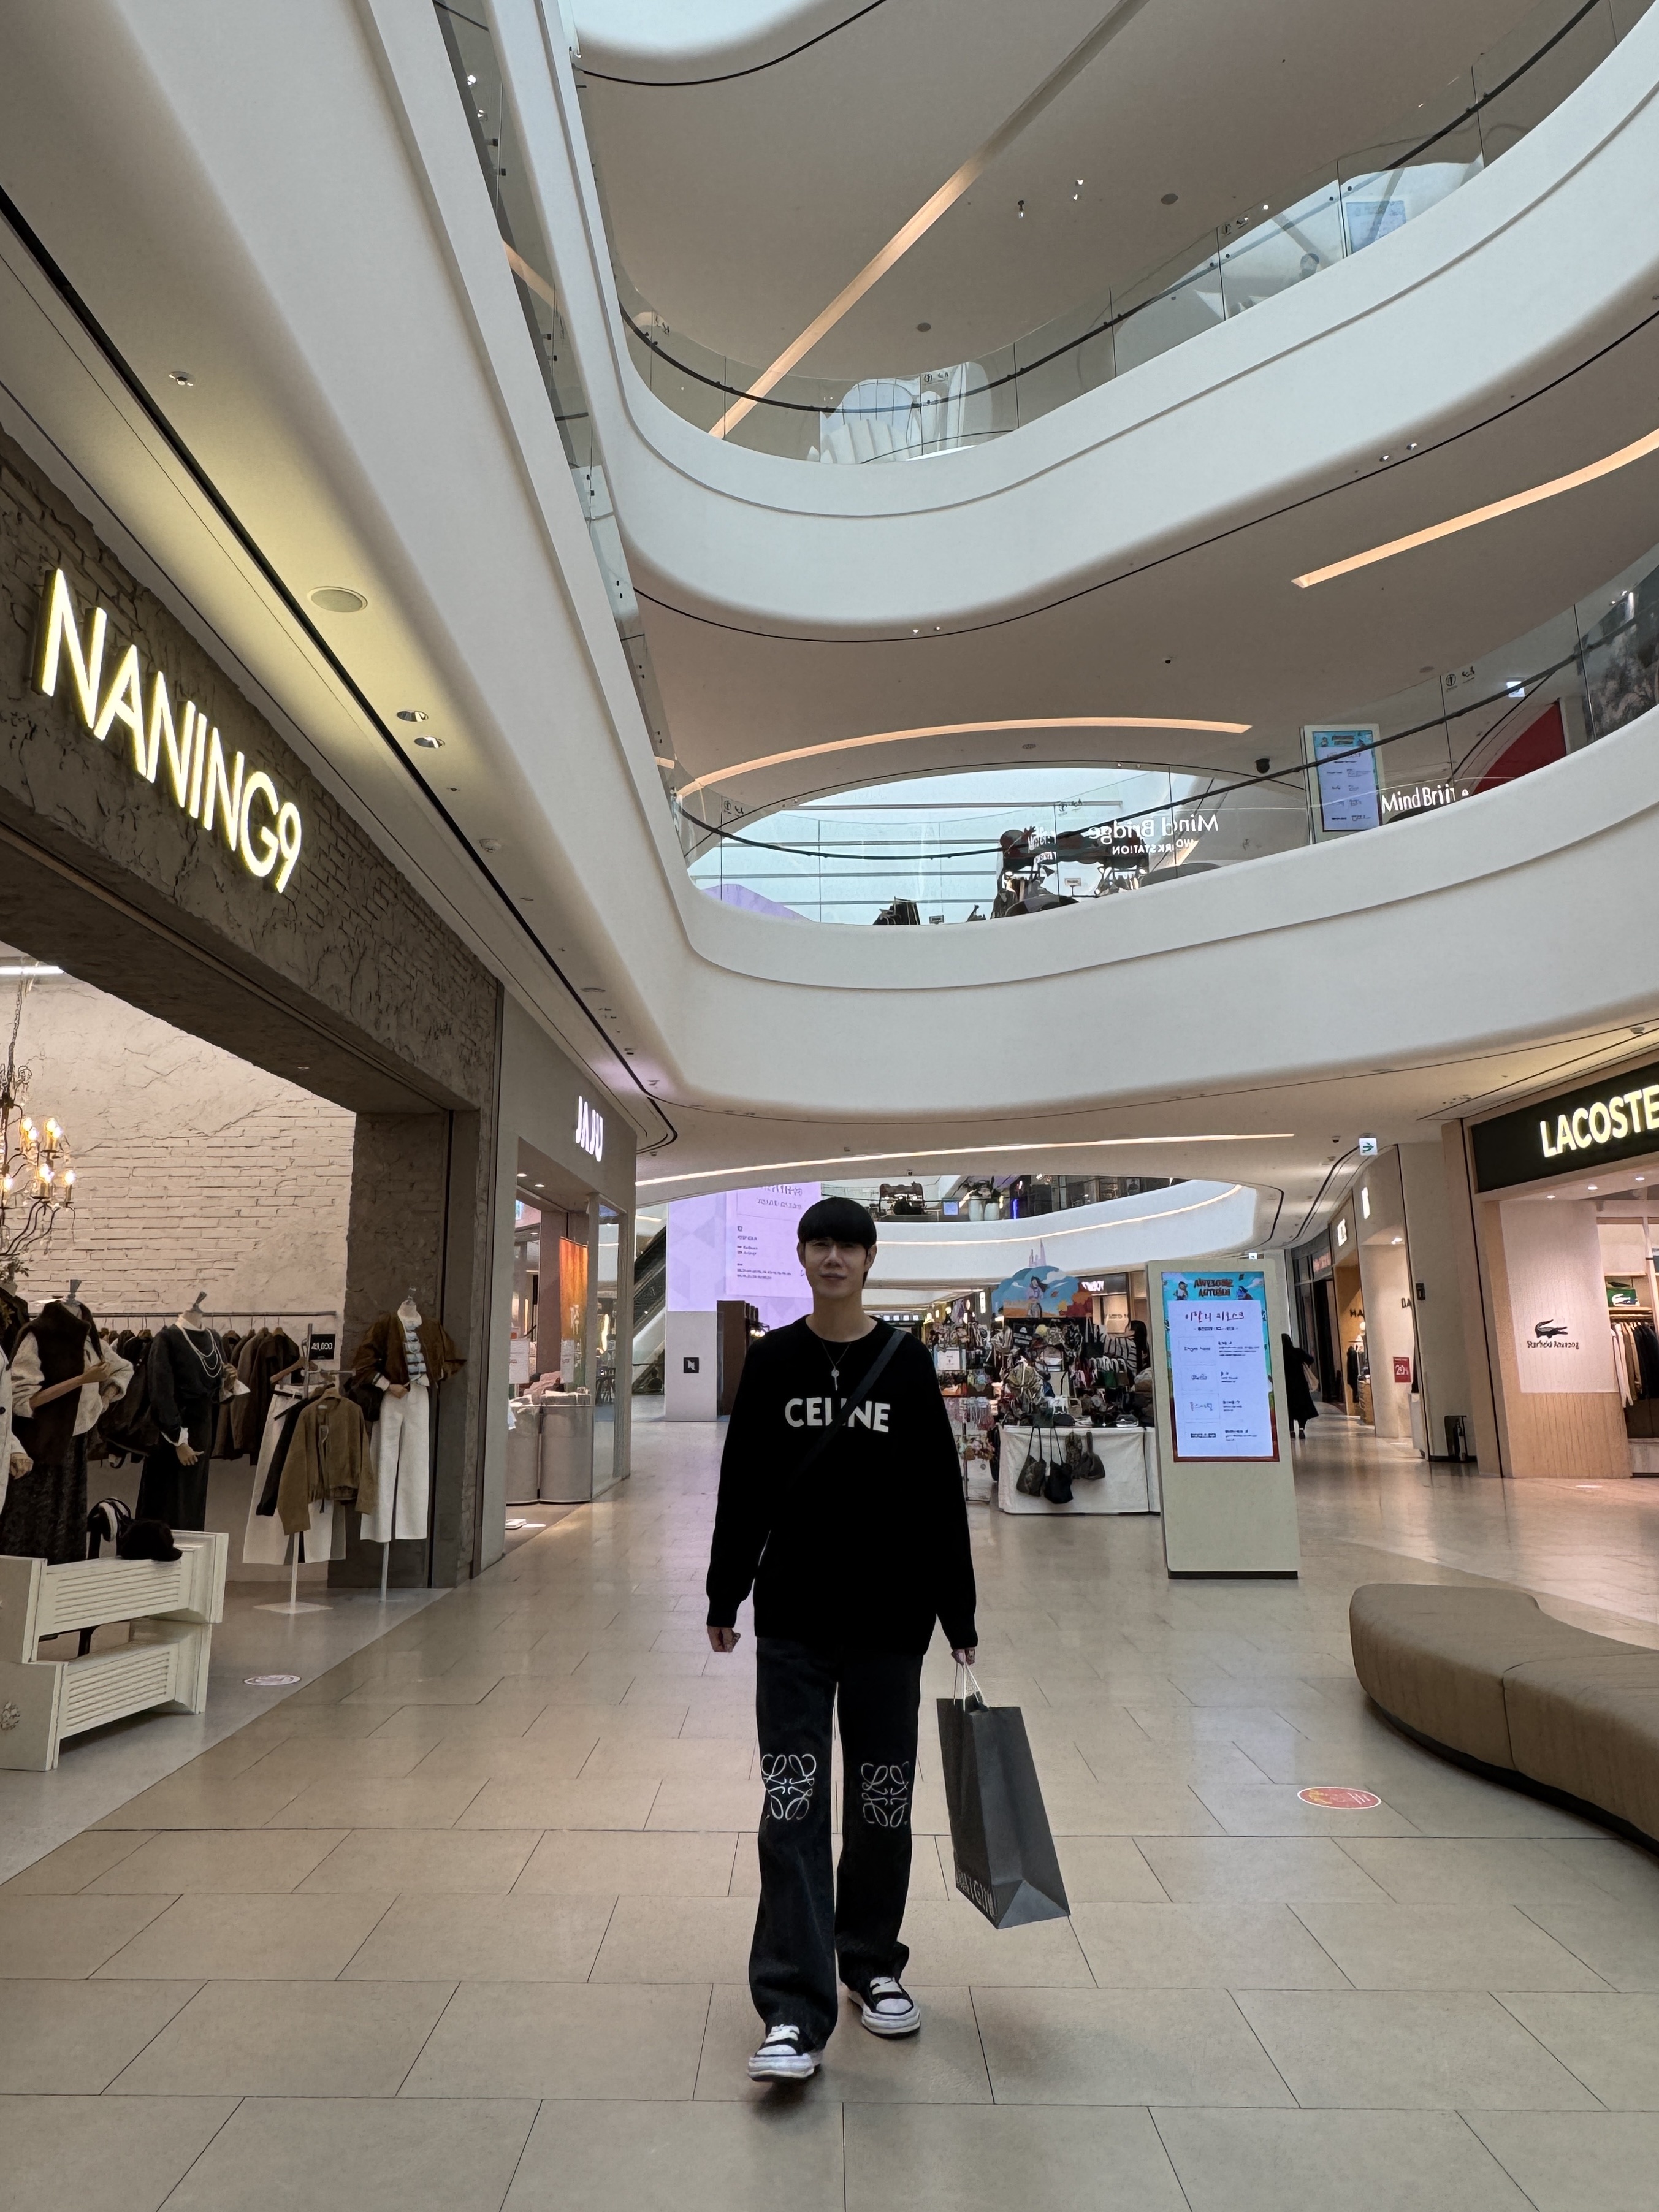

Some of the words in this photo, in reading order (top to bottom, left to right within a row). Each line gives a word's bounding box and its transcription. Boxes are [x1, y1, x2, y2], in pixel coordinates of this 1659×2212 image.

[38, 568, 302, 894] NANING9
[1382, 787, 1421, 814] Mind
[576, 1096, 603, 1162] JAJU
[1540, 1085, 1659, 1157] LACOSTE
